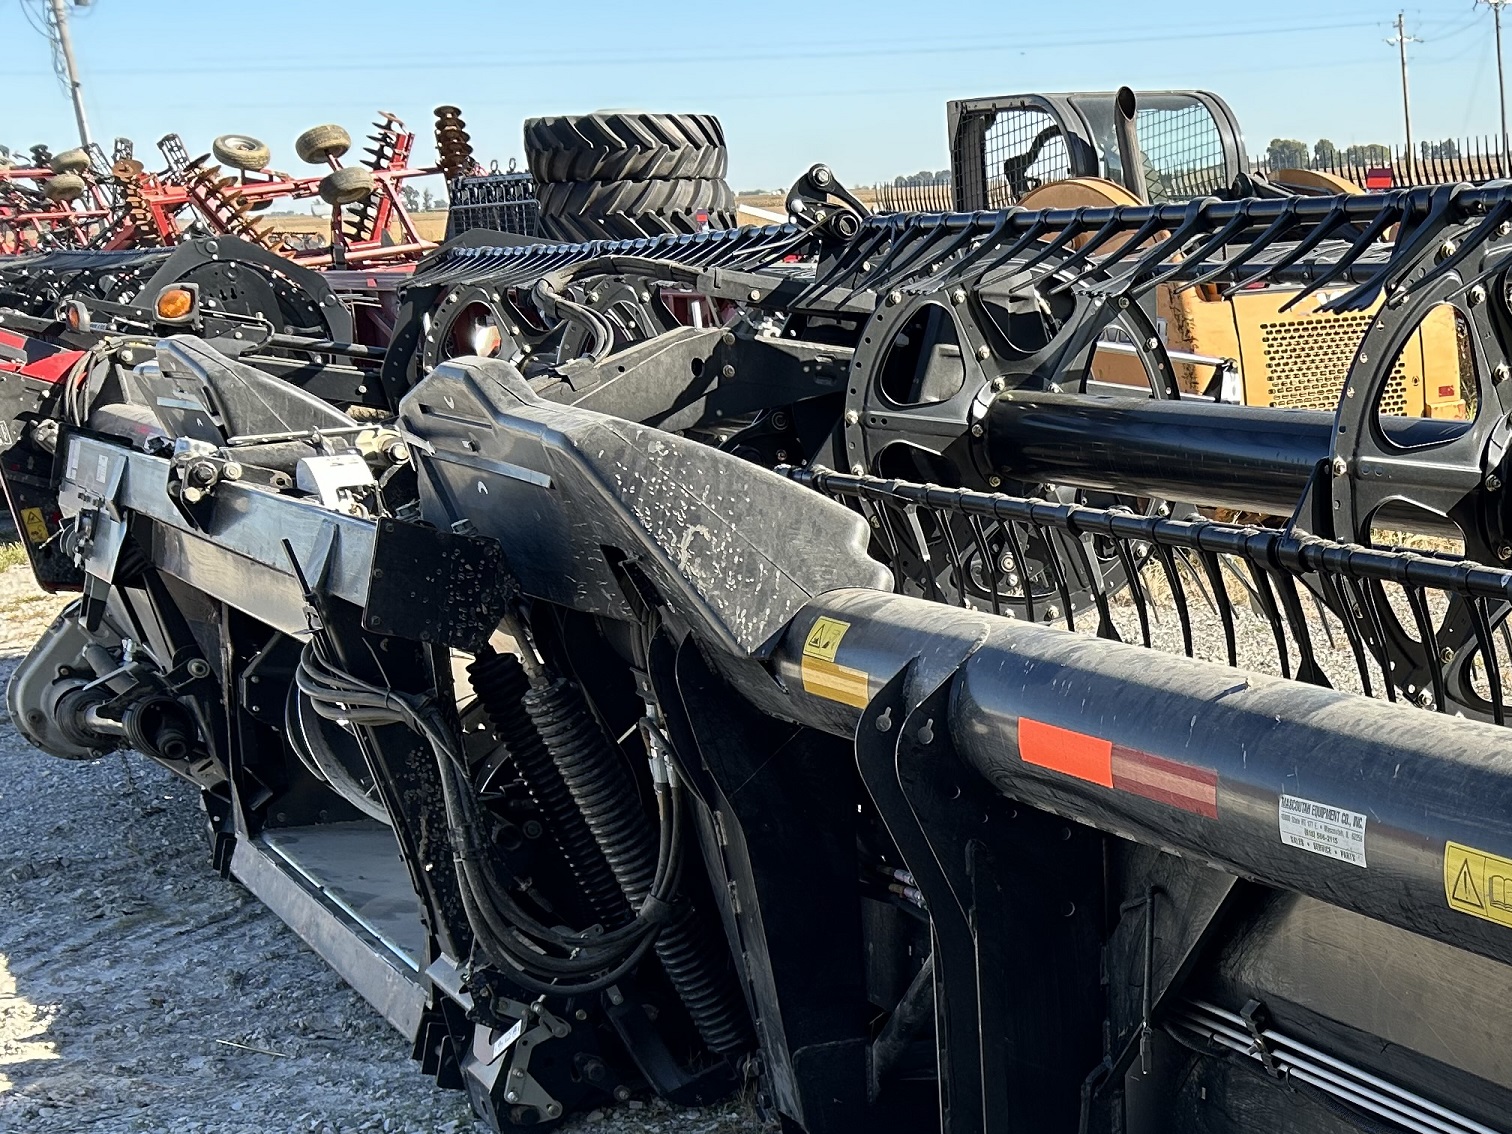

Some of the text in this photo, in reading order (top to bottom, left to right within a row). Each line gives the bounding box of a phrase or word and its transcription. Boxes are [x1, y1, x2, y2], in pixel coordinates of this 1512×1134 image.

[1281, 796, 1311, 815] MASCOUTAH
[1311, 804, 1340, 823] EQUIPMENT
[1353, 816, 1363, 830] INC.
[1312, 841, 1332, 854] SERVICE
[1340, 849, 1356, 862] PARTS
